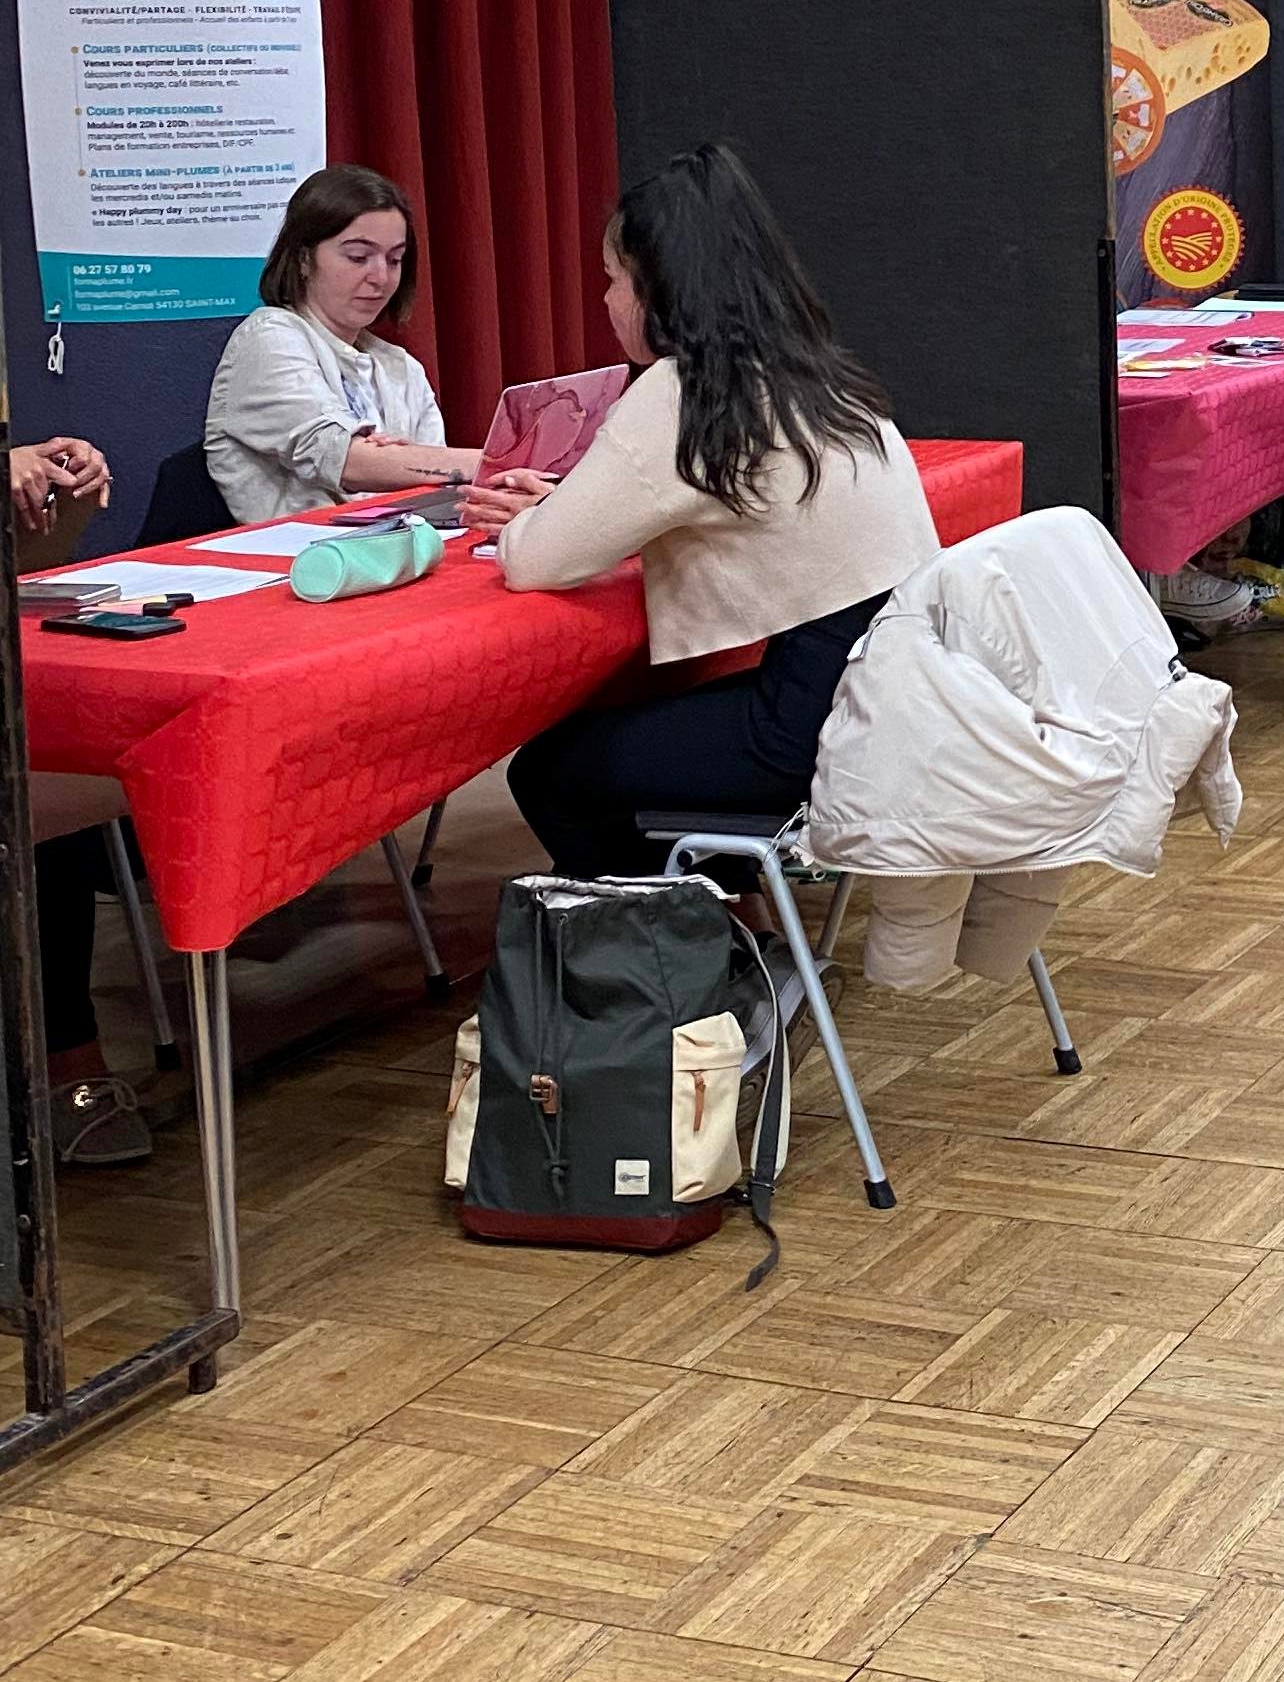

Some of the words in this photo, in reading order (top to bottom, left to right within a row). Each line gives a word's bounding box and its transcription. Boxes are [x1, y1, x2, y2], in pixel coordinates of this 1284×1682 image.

[83, 44, 121, 54] COURS
[124, 44, 204, 53] PARTICULIERS
[135, 59, 175, 68] exprimer
[87, 106, 125, 116] COURS
[99, 208, 127, 217] Happy
[166, 206, 183, 215] day
[73, 265, 87, 275] 06
[89, 265, 102, 274] 27
[104, 264, 118, 274] 57
[136, 263, 152, 274] 79
